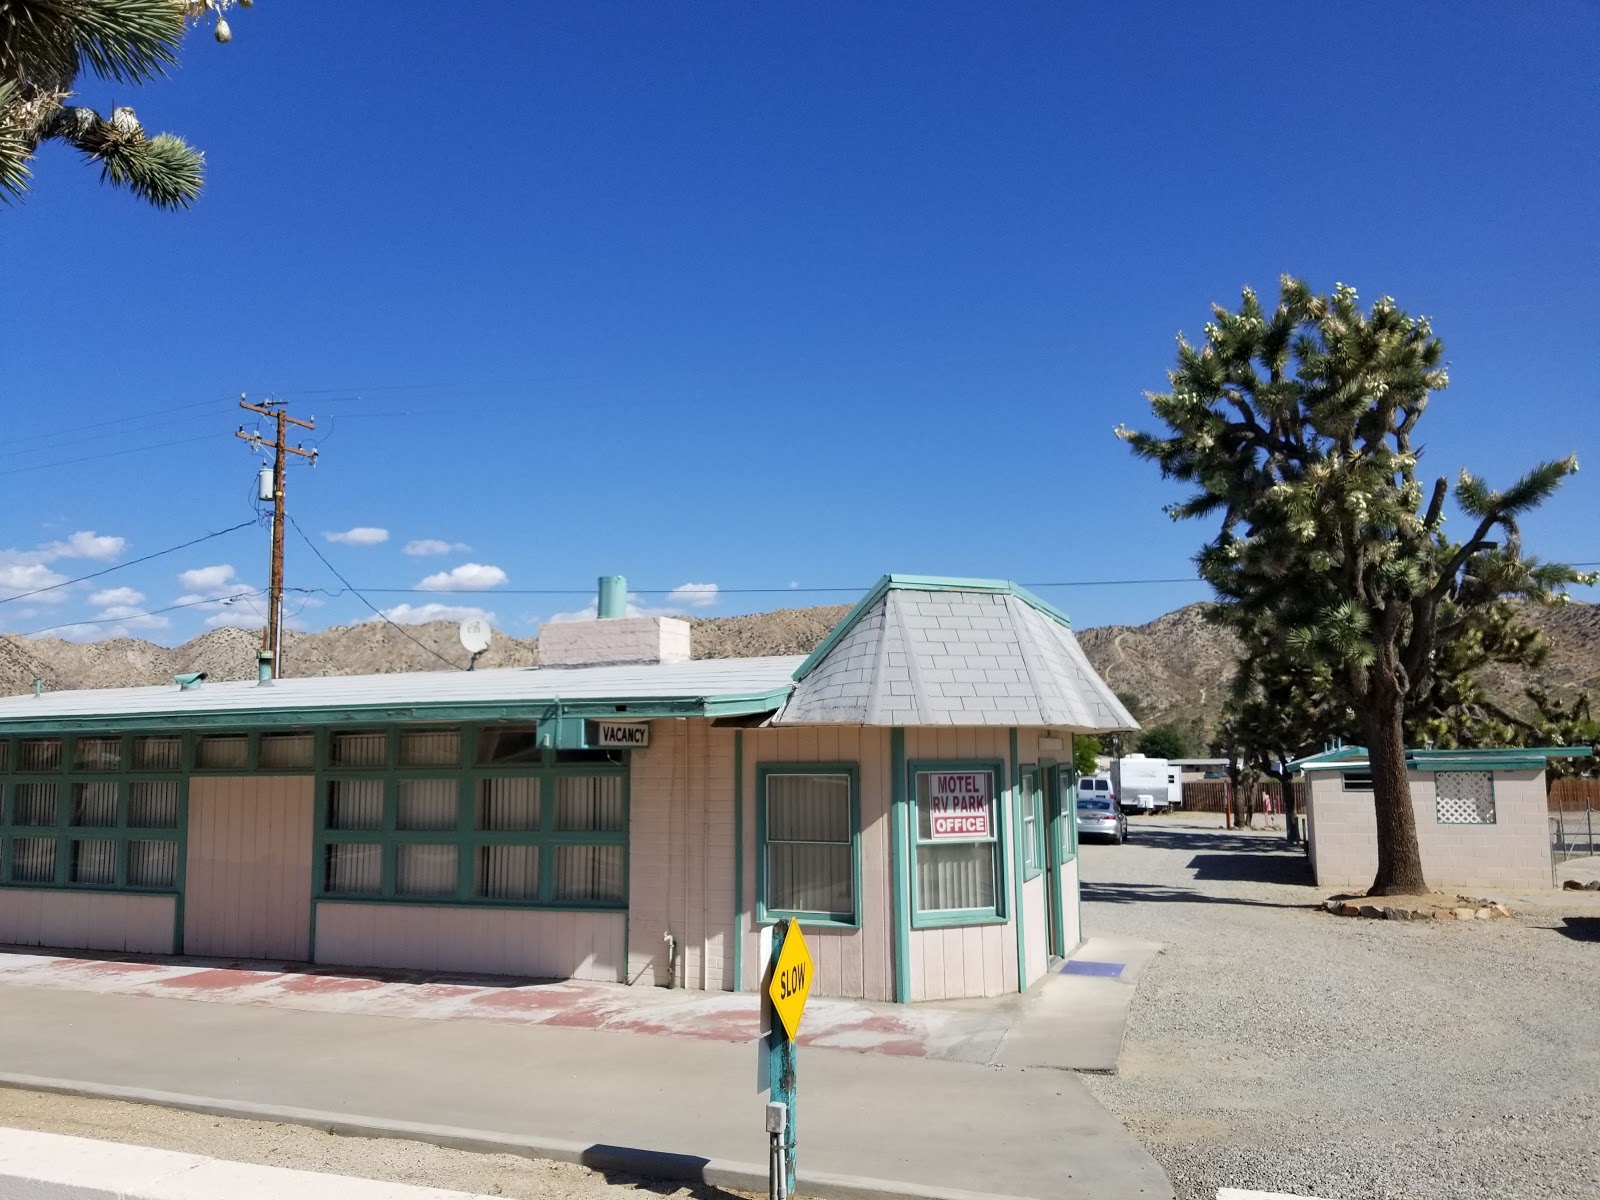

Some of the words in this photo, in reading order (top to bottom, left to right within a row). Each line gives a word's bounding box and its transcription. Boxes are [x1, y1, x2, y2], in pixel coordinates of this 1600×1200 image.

[603, 726, 645, 742] VACANCY
[937, 776, 979, 793] MOTEL
[933, 796, 948, 813] RV
[953, 795, 985, 812] PARK
[936, 818, 984, 832] OFFICE
[780, 961, 805, 1000] SLOW
